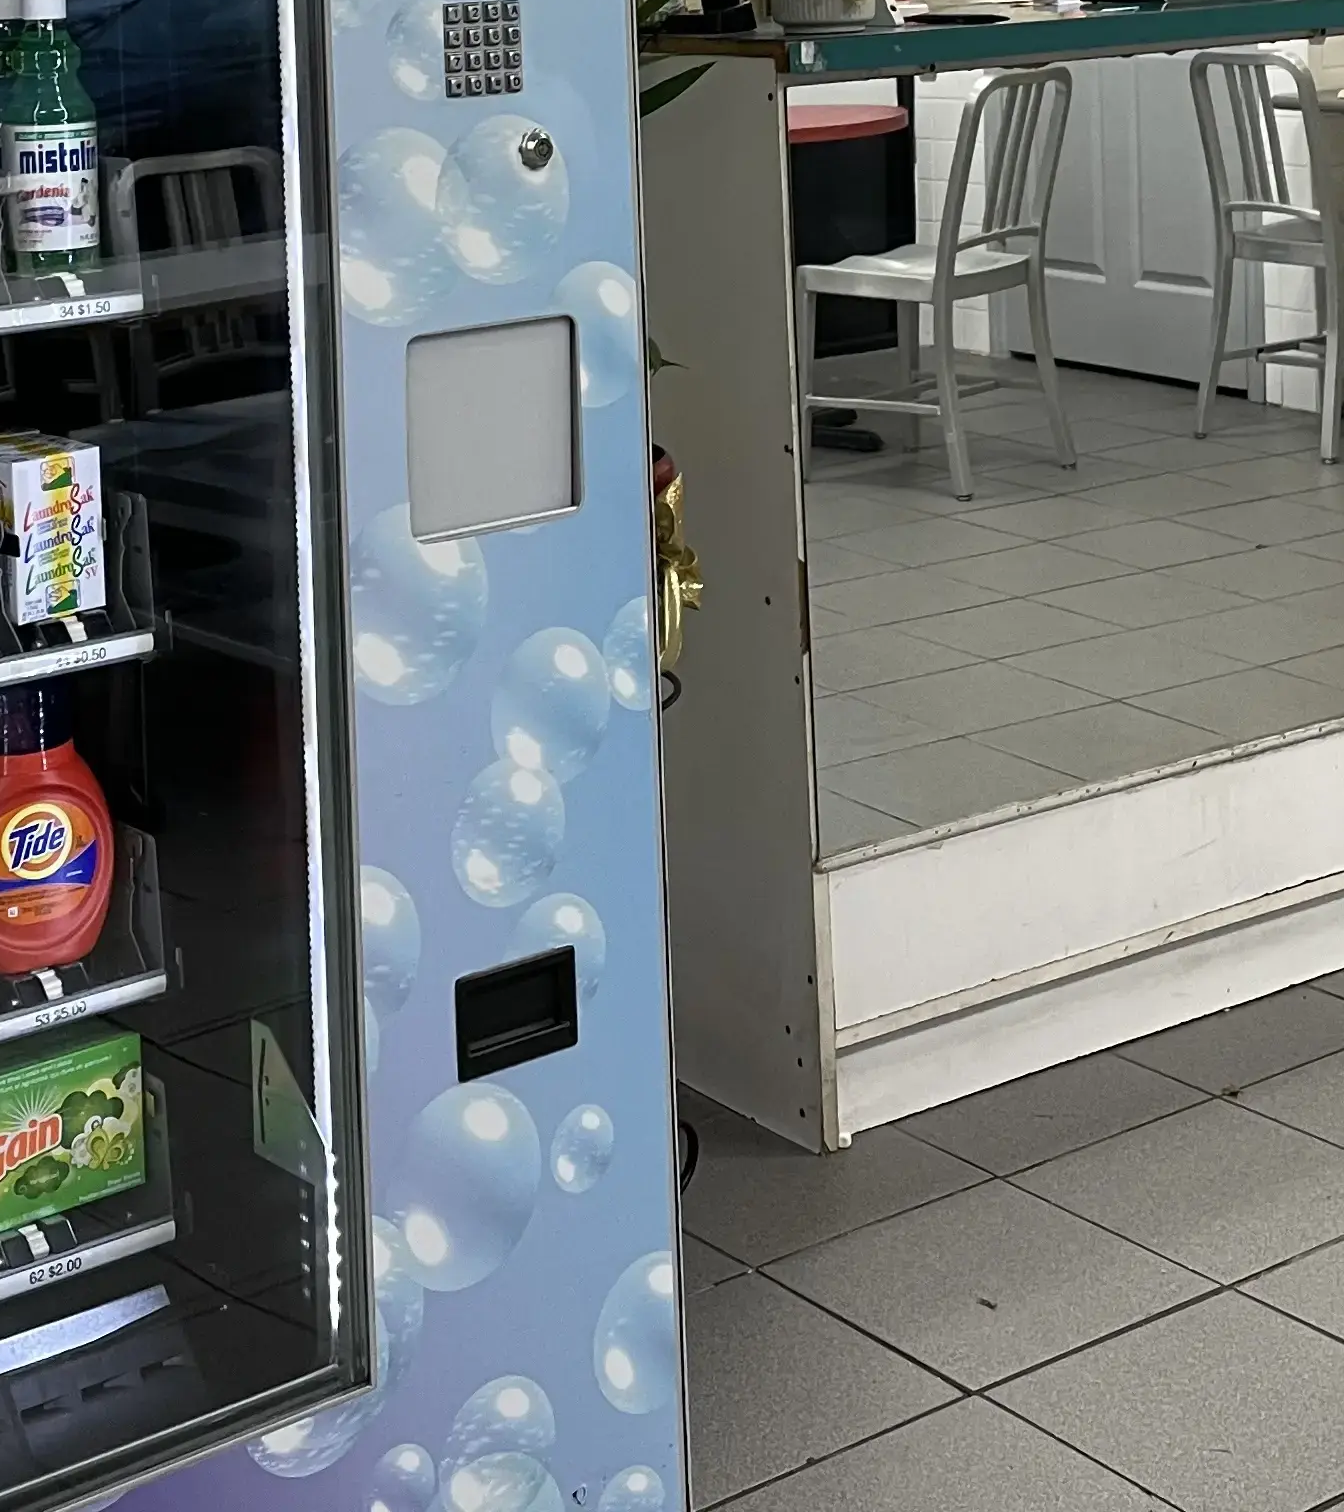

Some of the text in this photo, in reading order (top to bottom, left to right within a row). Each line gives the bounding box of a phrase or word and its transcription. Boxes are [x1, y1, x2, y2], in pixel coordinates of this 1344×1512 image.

[471, 7, 479, 18] 2
[491, 6, 499, 16] 3
[59, 300, 111, 318] 34 $1.50
[9, 820, 66, 871] Tide
[35, 1013, 50, 1027] 53
[29, 1257, 83, 1285] 62 $2.00
